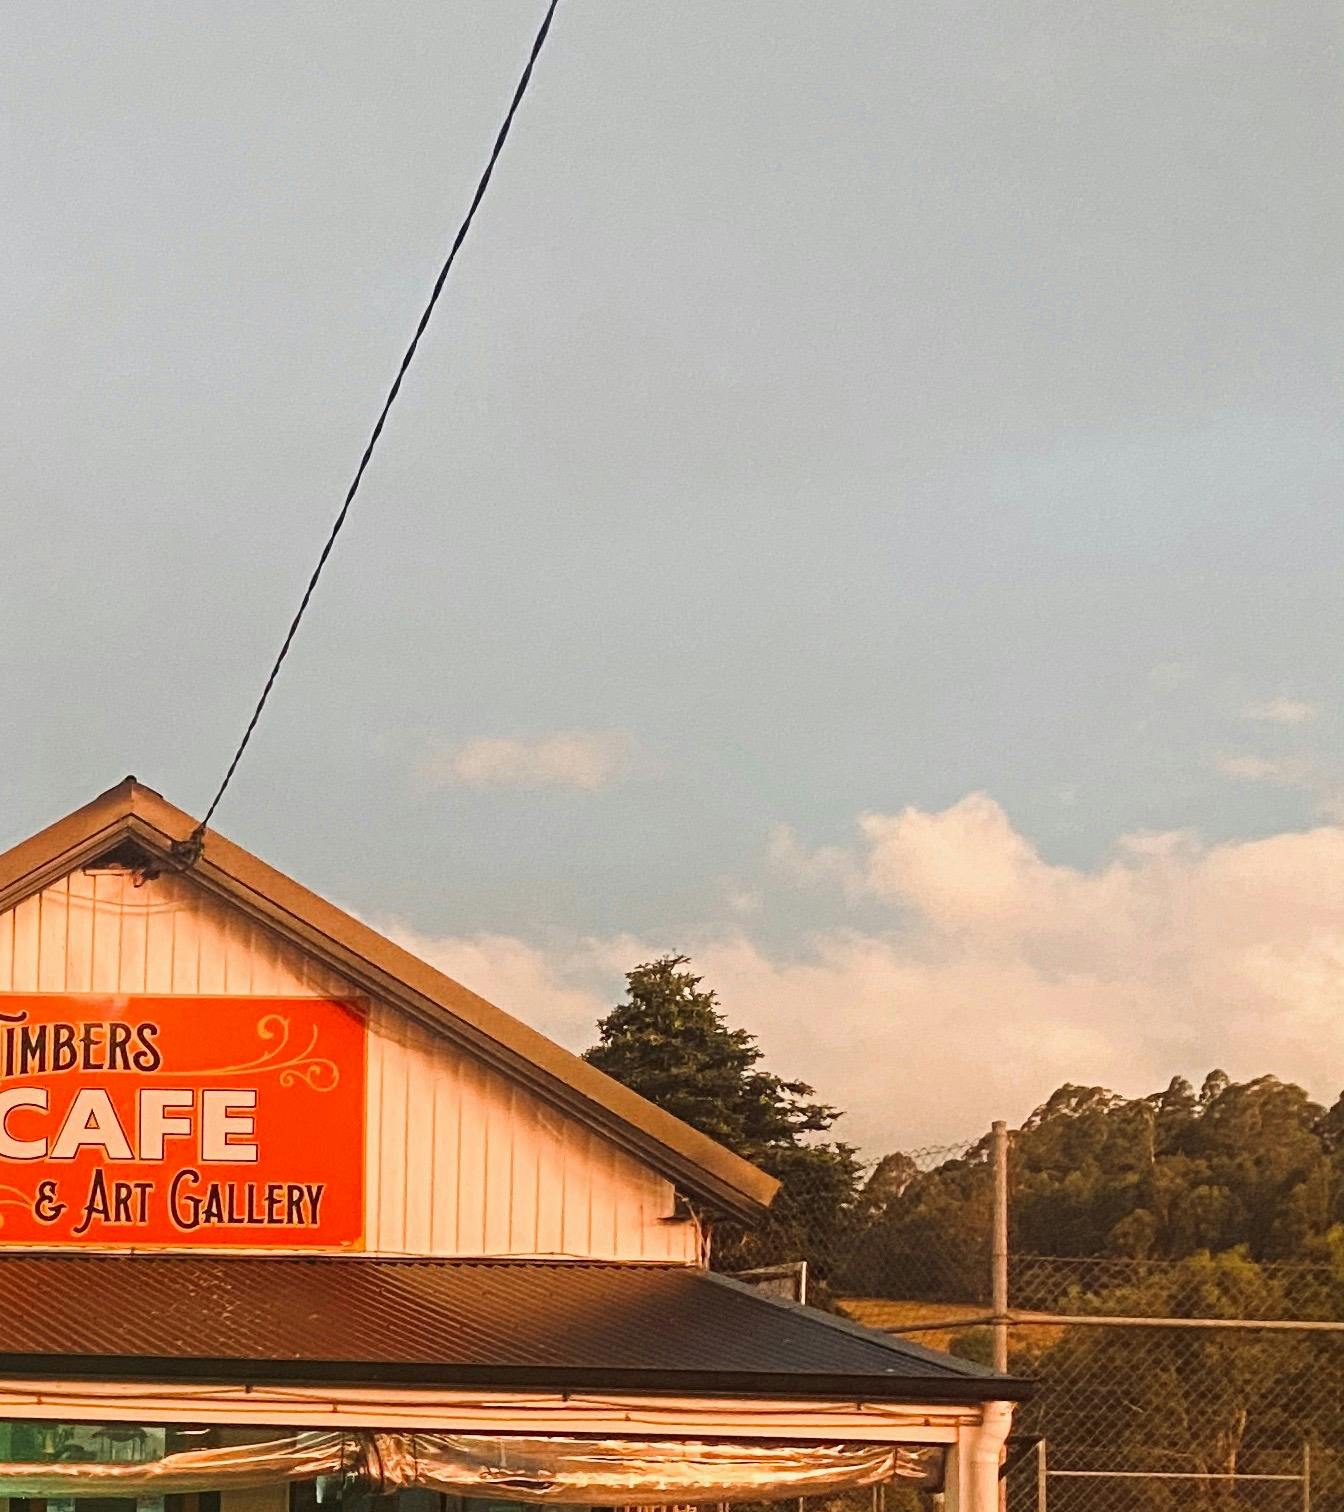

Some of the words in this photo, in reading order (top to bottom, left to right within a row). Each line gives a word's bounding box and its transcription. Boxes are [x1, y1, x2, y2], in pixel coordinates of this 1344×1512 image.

[34, 1180, 68, 1222] &
[73, 1168, 154, 1234] ART
[170, 1168, 325, 1229] GALLERY
